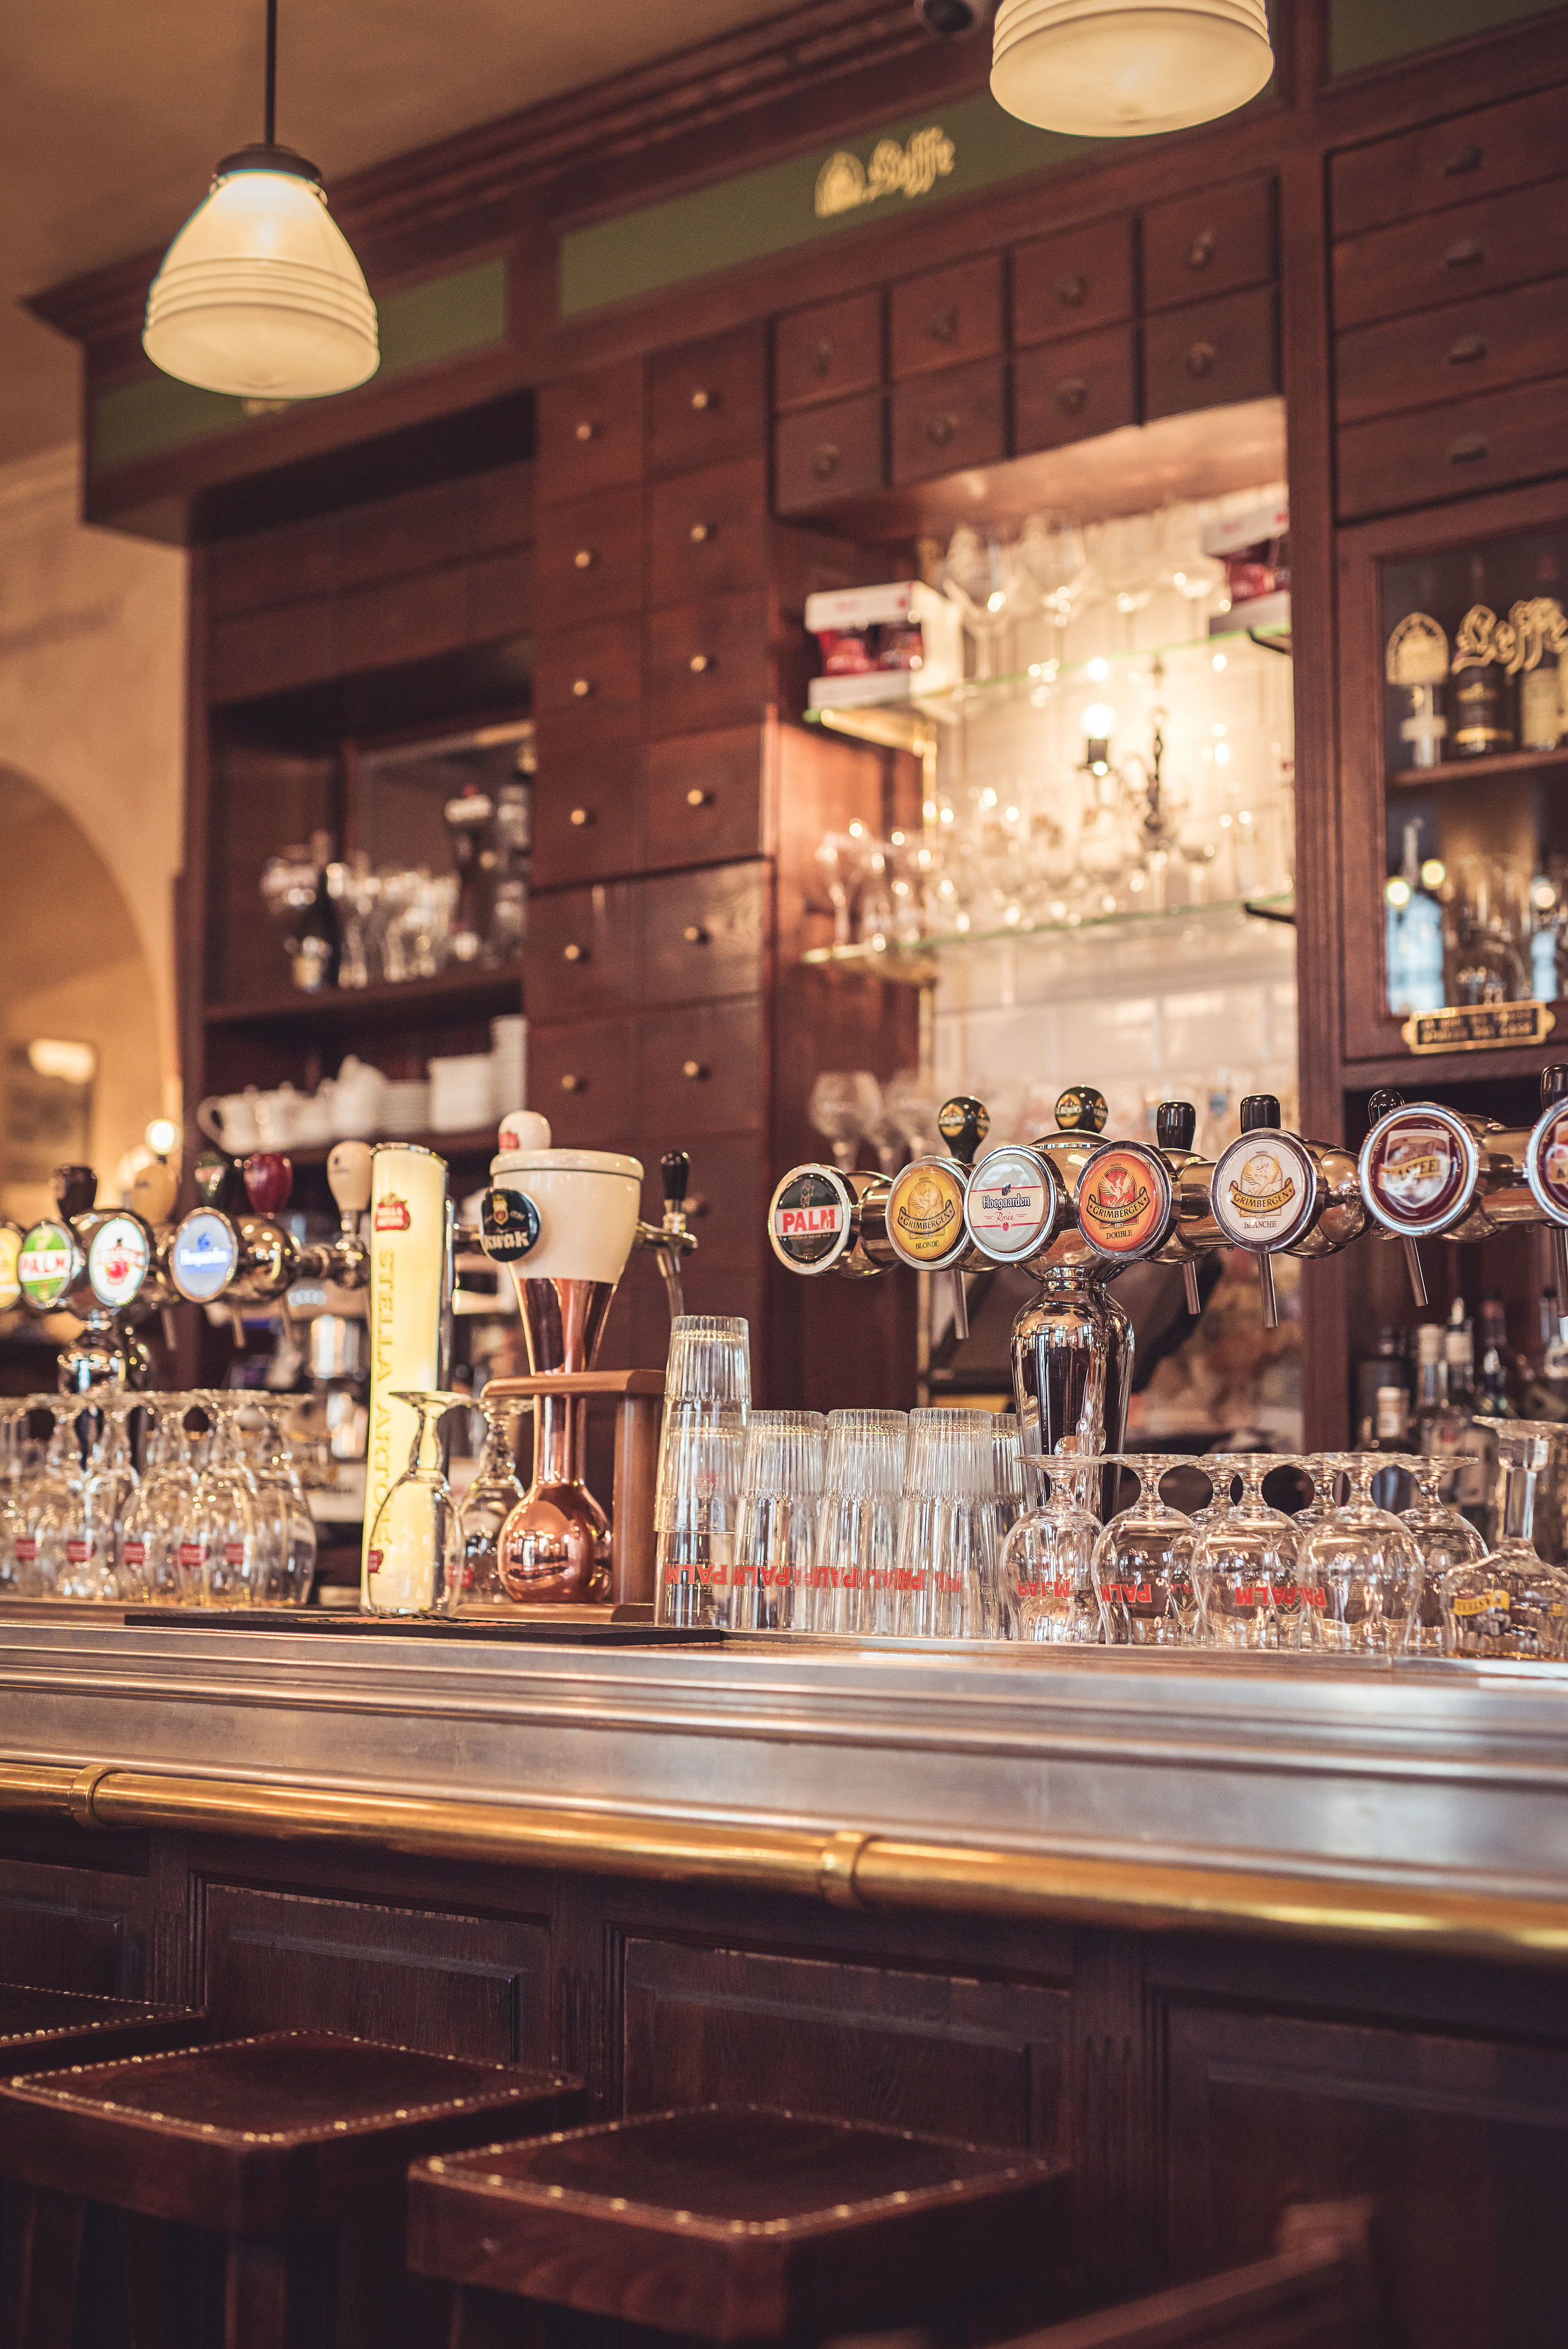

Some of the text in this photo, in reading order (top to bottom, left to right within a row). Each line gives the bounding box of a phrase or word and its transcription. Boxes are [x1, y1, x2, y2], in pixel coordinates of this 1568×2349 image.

[982, 1193, 1031, 1210] Hoegaarden
[1234, 1191, 1289, 1208] GRIMBERGEN
[1093, 1199, 1144, 1218] GRIMBERGEN
[783, 1209, 835, 1233] PALM
[903, 1212, 950, 1230] GRIMBERGEN
[995, 1212, 1015, 1223] Rosée
[1106, 1230, 1133, 1239] DOUBLE
[916, 1240, 939, 1250] BLONDE
[21, 1256, 68, 1273] PALM
[375, 1247, 394, 1383] STELLA
[665, 1563, 728, 1585] PALM
[1099, 1583, 1152, 1603] PALM
